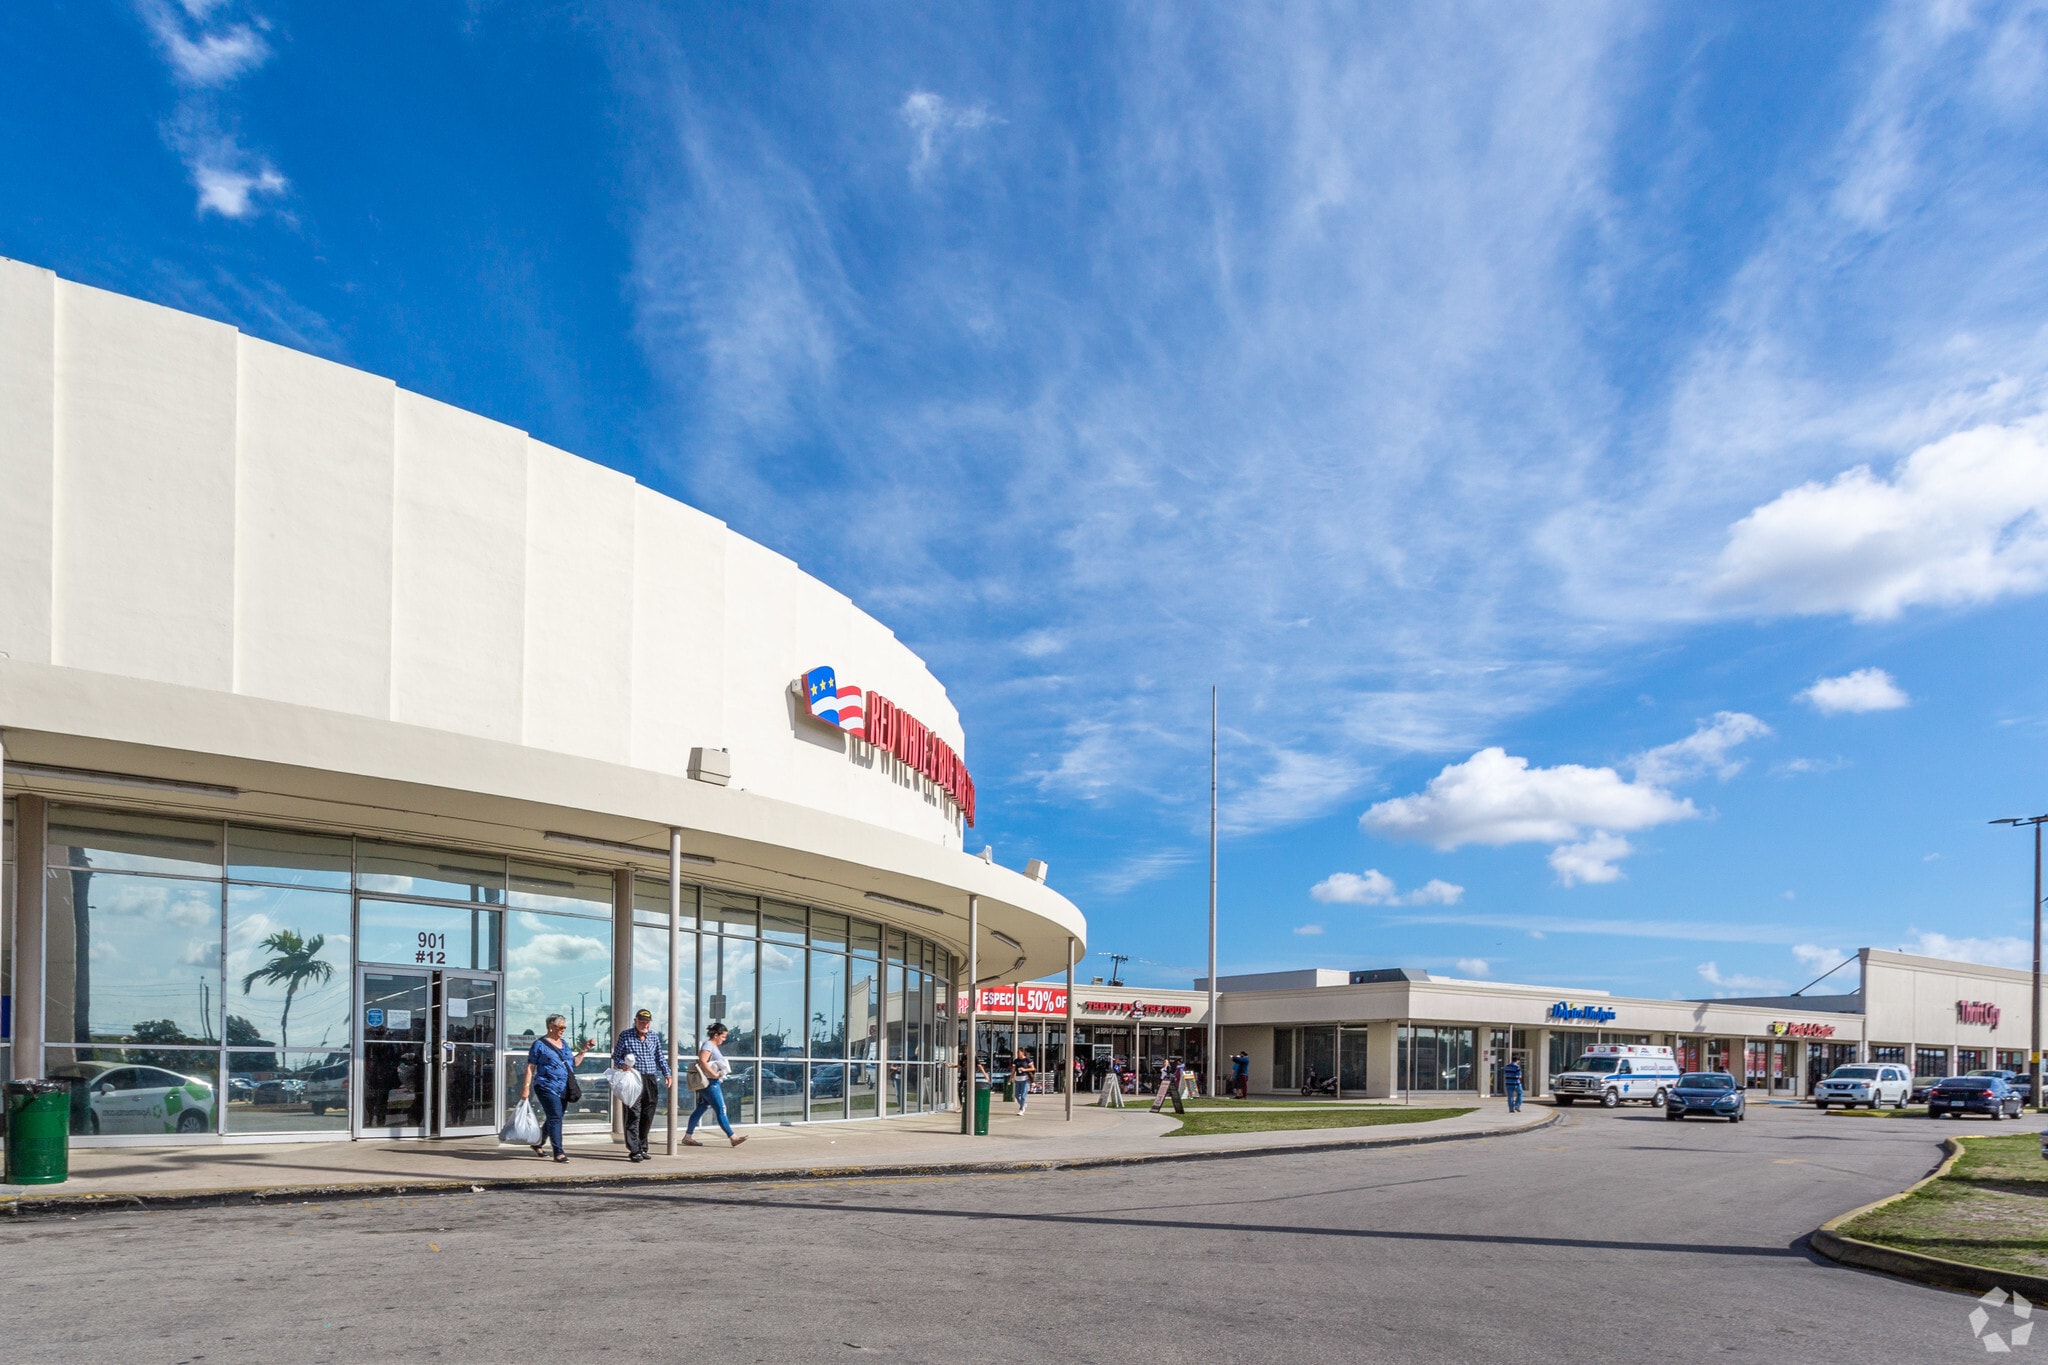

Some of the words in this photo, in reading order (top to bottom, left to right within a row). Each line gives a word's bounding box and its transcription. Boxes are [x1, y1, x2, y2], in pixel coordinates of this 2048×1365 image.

[866, 691, 896, 753] RED
[896, 708, 929, 776] WHITE
[417, 931, 445, 949] 901
[415, 950, 446, 964] #12
[982, 992, 1025, 1006] ESPECIL
[1027, 990, 1055, 1012] 50%
[1087, 1001, 1120, 1011] THRIFT
[1121, 1003, 1134, 1012] BY
[1144, 1004, 1162, 1013] THE
[1163, 1005, 1192, 1014] POUND
[1958, 1000, 1984, 1023] Thrift
[1984, 1002, 2000, 1029] City
